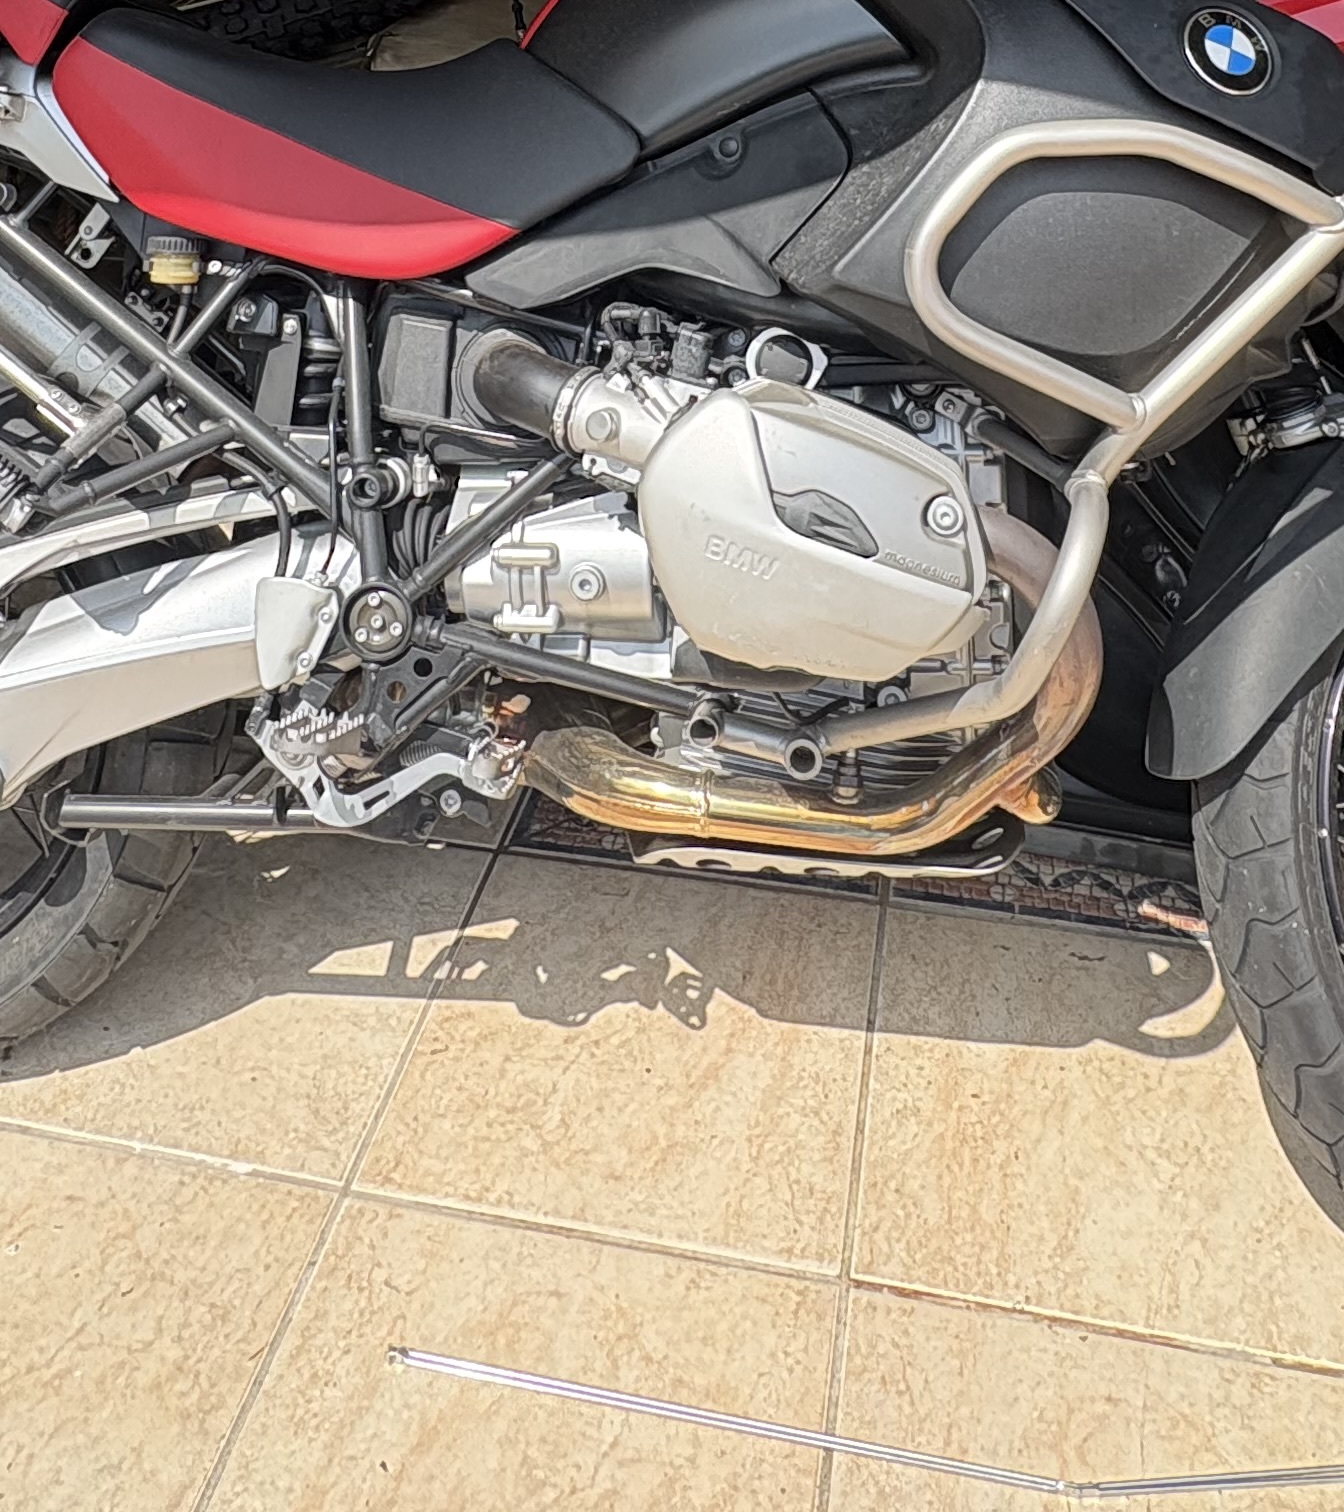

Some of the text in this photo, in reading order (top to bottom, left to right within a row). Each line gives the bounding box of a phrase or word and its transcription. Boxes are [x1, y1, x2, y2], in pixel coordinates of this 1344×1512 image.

[1197, 13, 1268, 52] BMW
[705, 533, 781, 581] BMW
[884, 550, 961, 586] magnesium
